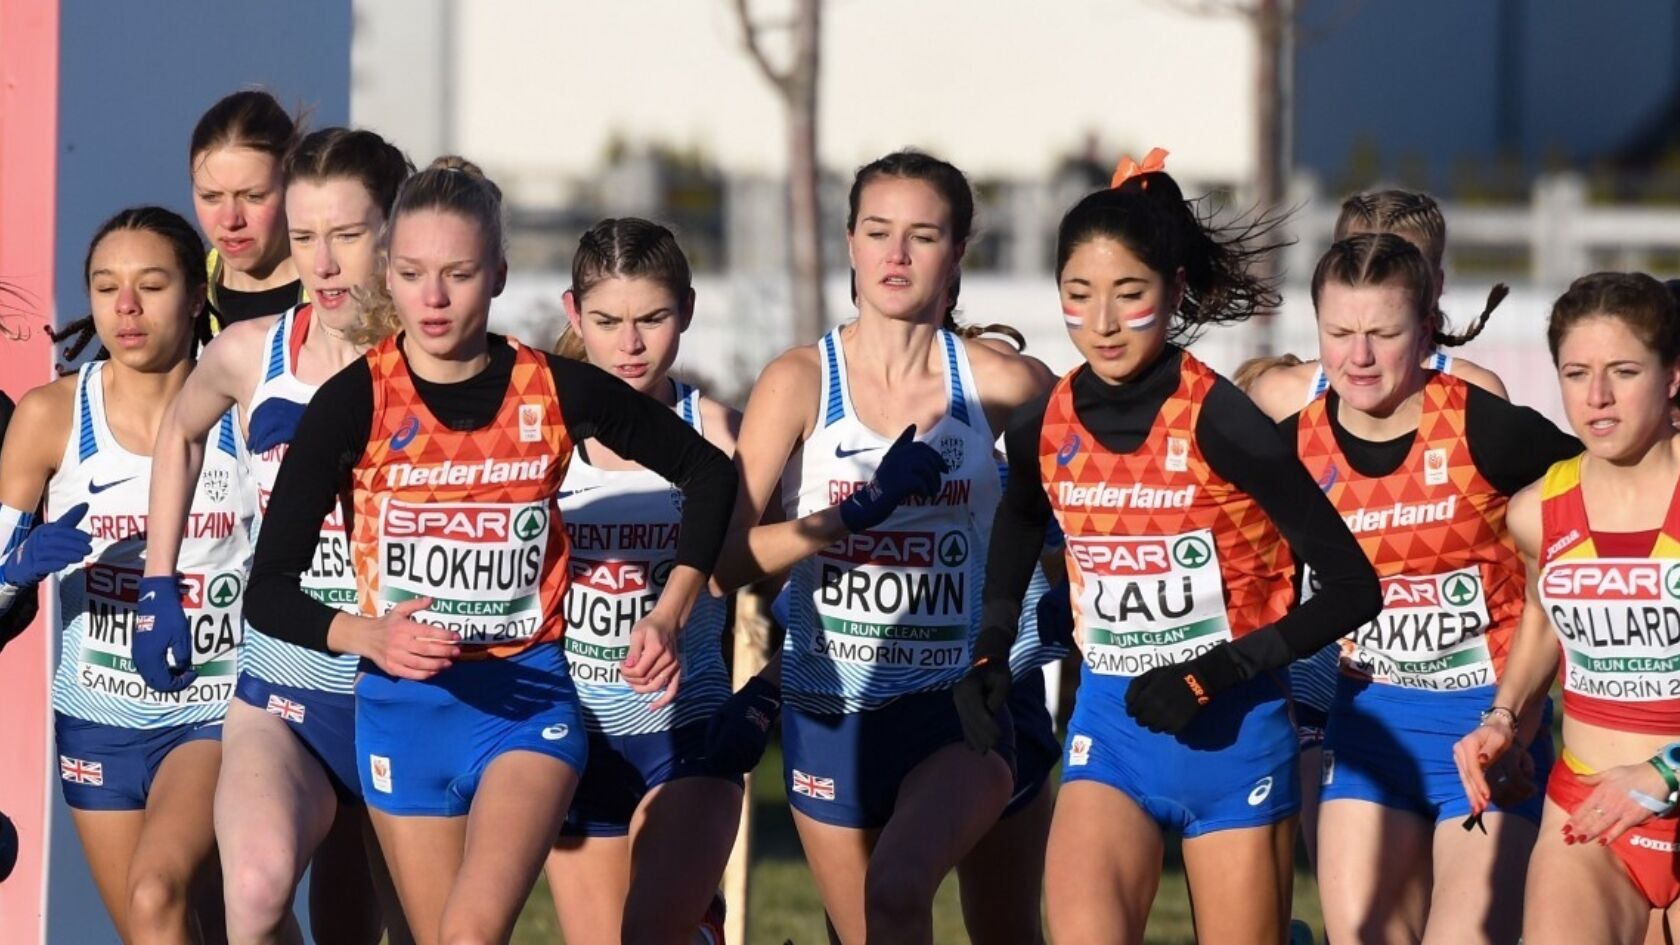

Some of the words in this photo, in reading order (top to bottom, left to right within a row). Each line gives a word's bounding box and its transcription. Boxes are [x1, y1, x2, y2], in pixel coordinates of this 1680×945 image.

[387, 511, 507, 538] SPAR
[1342, 494, 1456, 534] derland
[567, 523, 617, 550] REAT
[619, 523, 680, 550] BRITA
[386, 542, 540, 590] BLOKHUIS
[1072, 544, 1168, 571] SPAR
[90, 566, 201, 604] SPR
[569, 560, 644, 590] PAR
[1545, 567, 1658, 596] SPAR
[821, 563, 964, 615] BROWN
[1094, 576, 1194, 622] LAU
[1384, 581, 1438, 606] AR
[431, 599, 452, 613] UN
[493, 617, 538, 640] 2017
[843, 622, 848, 633] I
[850, 623, 881, 637] RUN
[1353, 611, 1482, 652] AKKER
[571, 641, 599, 658] RUN
[602, 648, 626, 660] CLE
[813, 628, 914, 665] ŠAMORÍN
[919, 647, 963, 666] 2017
[1443, 667, 1489, 690] 2017
[1593, 659, 1625, 671] RUN
[186, 683, 232, 703] 2017
[1569, 666, 1662, 698] ŠAMORÍN
